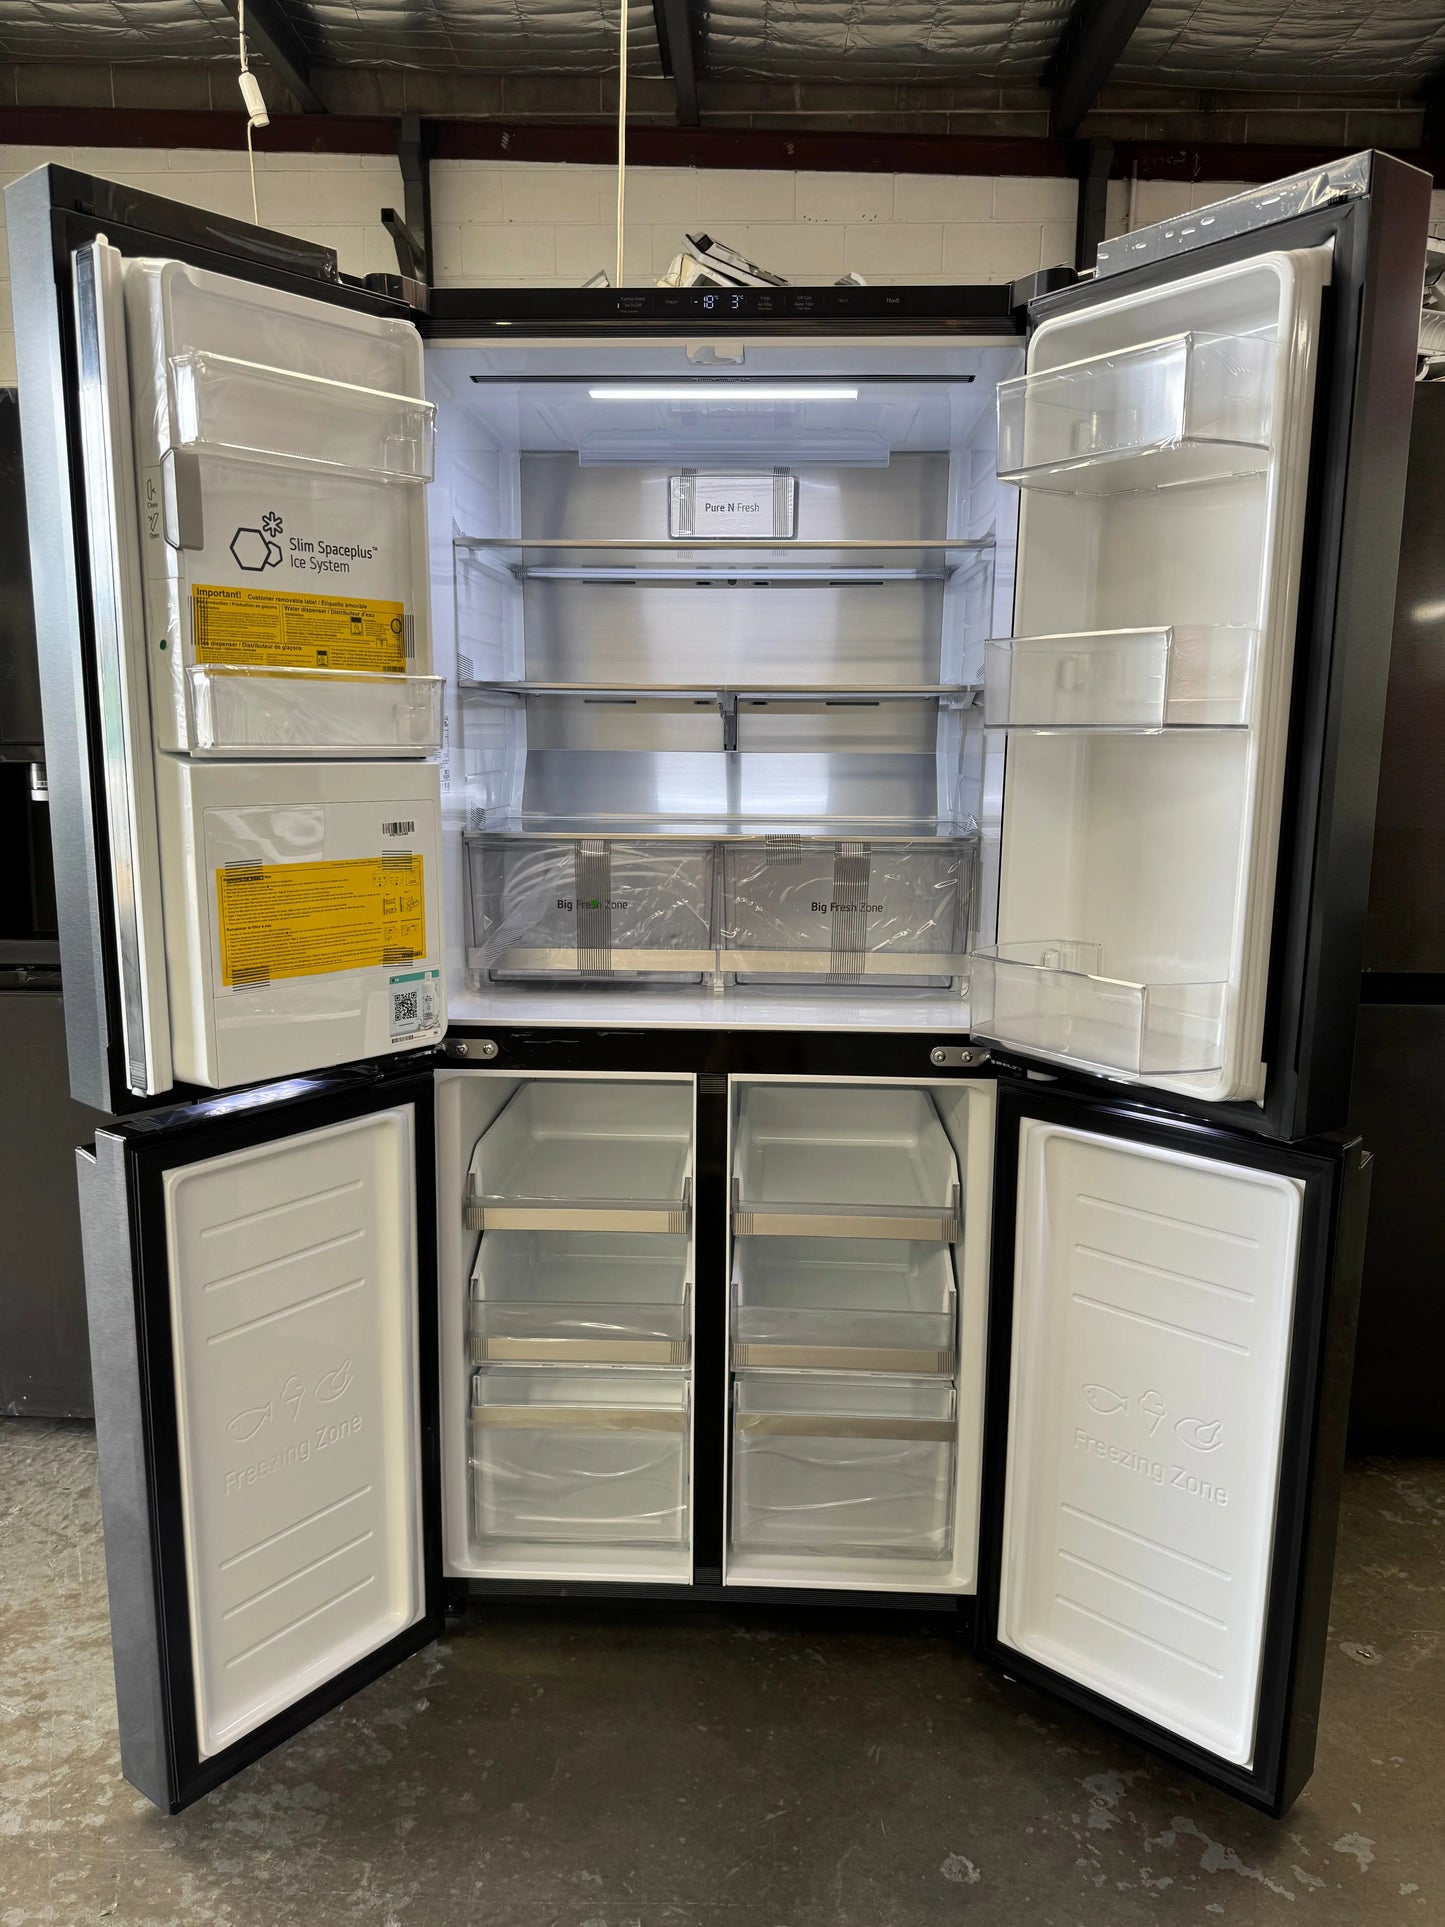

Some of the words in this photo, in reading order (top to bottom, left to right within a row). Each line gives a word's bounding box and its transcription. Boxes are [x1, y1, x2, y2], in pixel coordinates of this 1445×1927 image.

[705, 503, 726, 512] Pure
[727, 503, 735, 512] N
[737, 502, 760, 513] Fresh
[289, 537, 314, 553] Slim
[290, 554, 306, 569] Ice
[309, 556, 350, 574] System
[196, 587, 242, 600] Important!
[247, 594, 274, 602] Customer
[275, 597, 304, 605] removable
[284, 605, 300, 613] Water
[300, 606, 327, 615] dispenser
[331, 608, 360, 617] Distributeur
[210, 641, 238, 649] dispenser
[242, 642, 273, 650] Distributeur
[557, 899, 573, 911] Big
[605, 900, 628, 910] Zone
[811, 902, 828, 914] Big
[830, 902, 857, 912] Fresh
[859, 903, 883, 912] Zone
[224, 1440, 311, 1496] Freezing
[315, 1414, 362, 1451] Zone
[1073, 1426, 1165, 1486] Freezing
[1170, 1464, 1228, 1506] Zone
